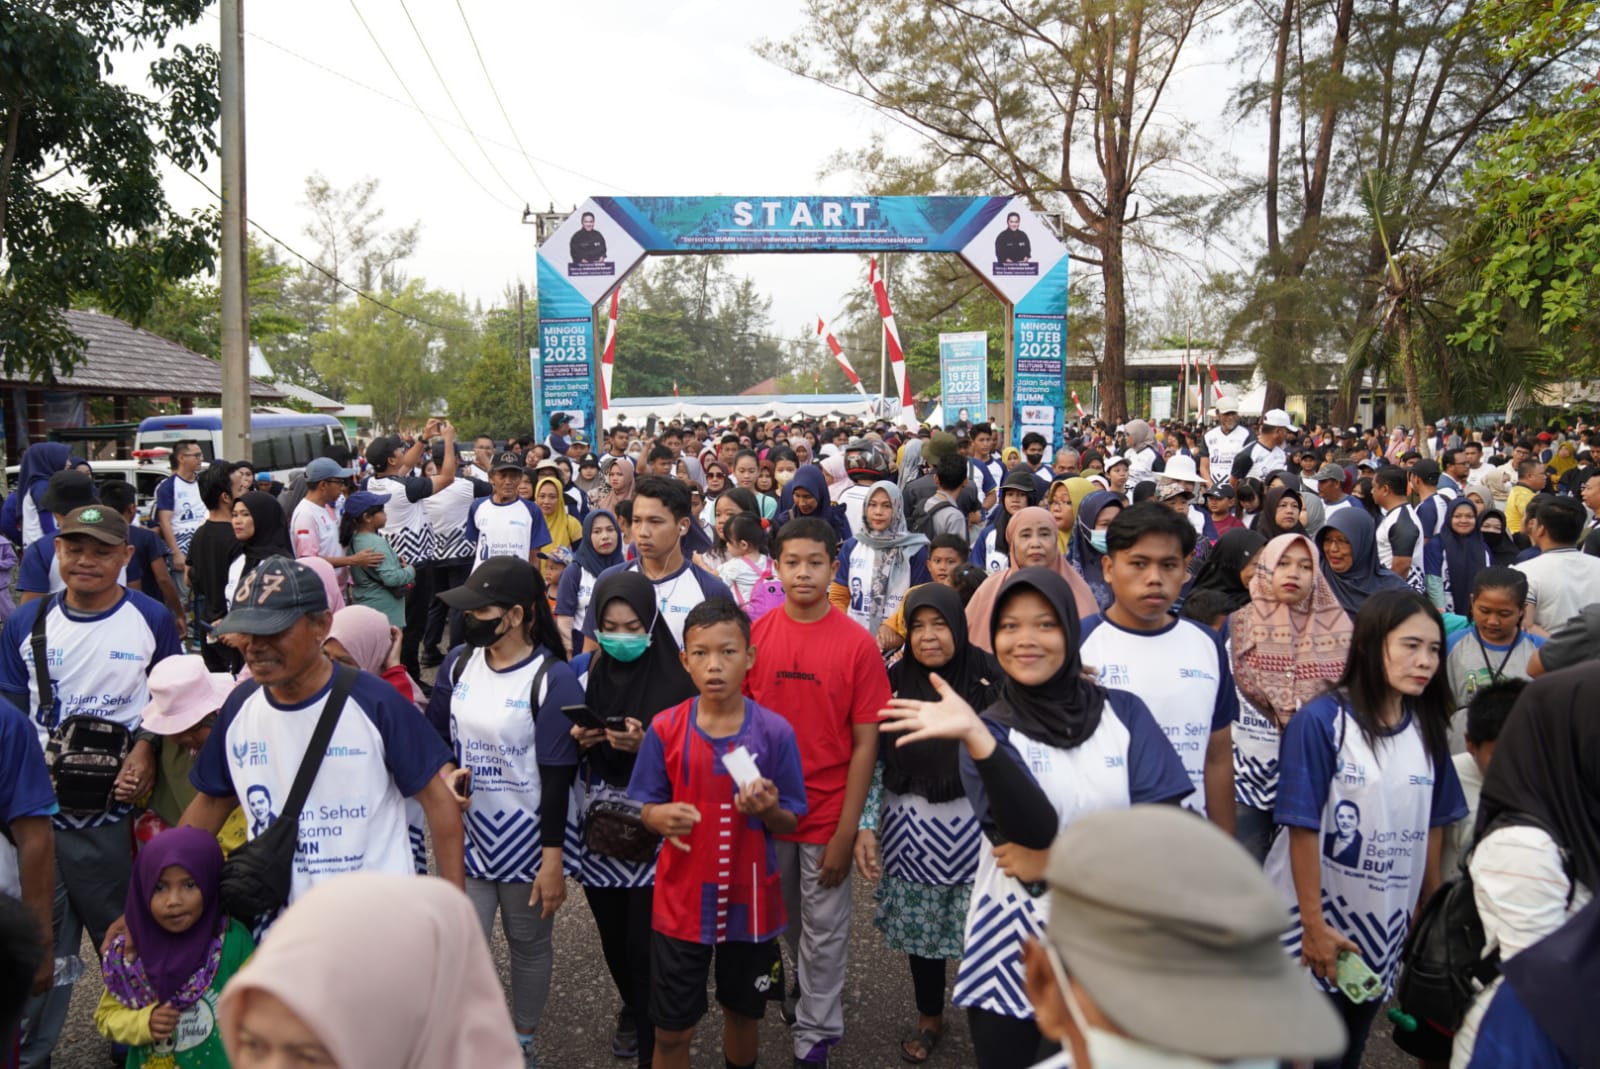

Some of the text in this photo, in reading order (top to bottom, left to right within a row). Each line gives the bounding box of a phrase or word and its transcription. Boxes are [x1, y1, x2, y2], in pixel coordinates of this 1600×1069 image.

[733, 201, 871, 227] START
[544, 326, 586, 335] MINGGU
[1021, 322, 1061, 331] MINGGU
[545, 335, 586, 347] 19 FEB
[1021, 331, 1061, 343] 19 FEB
[544, 347, 587, 362] 2023
[1019, 343, 1061, 358] 2023
[948, 371, 980, 381] 19 FEB
[948, 381, 980, 393] 2023
[545, 398, 573, 407] BUMN
[1016, 393, 1044, 402] BUMN
[235, 571, 286, 605] 87
[66, 694, 98, 705] Jalan
[465, 738, 498, 752] Jalan
[319, 804, 367, 821] Sehat
